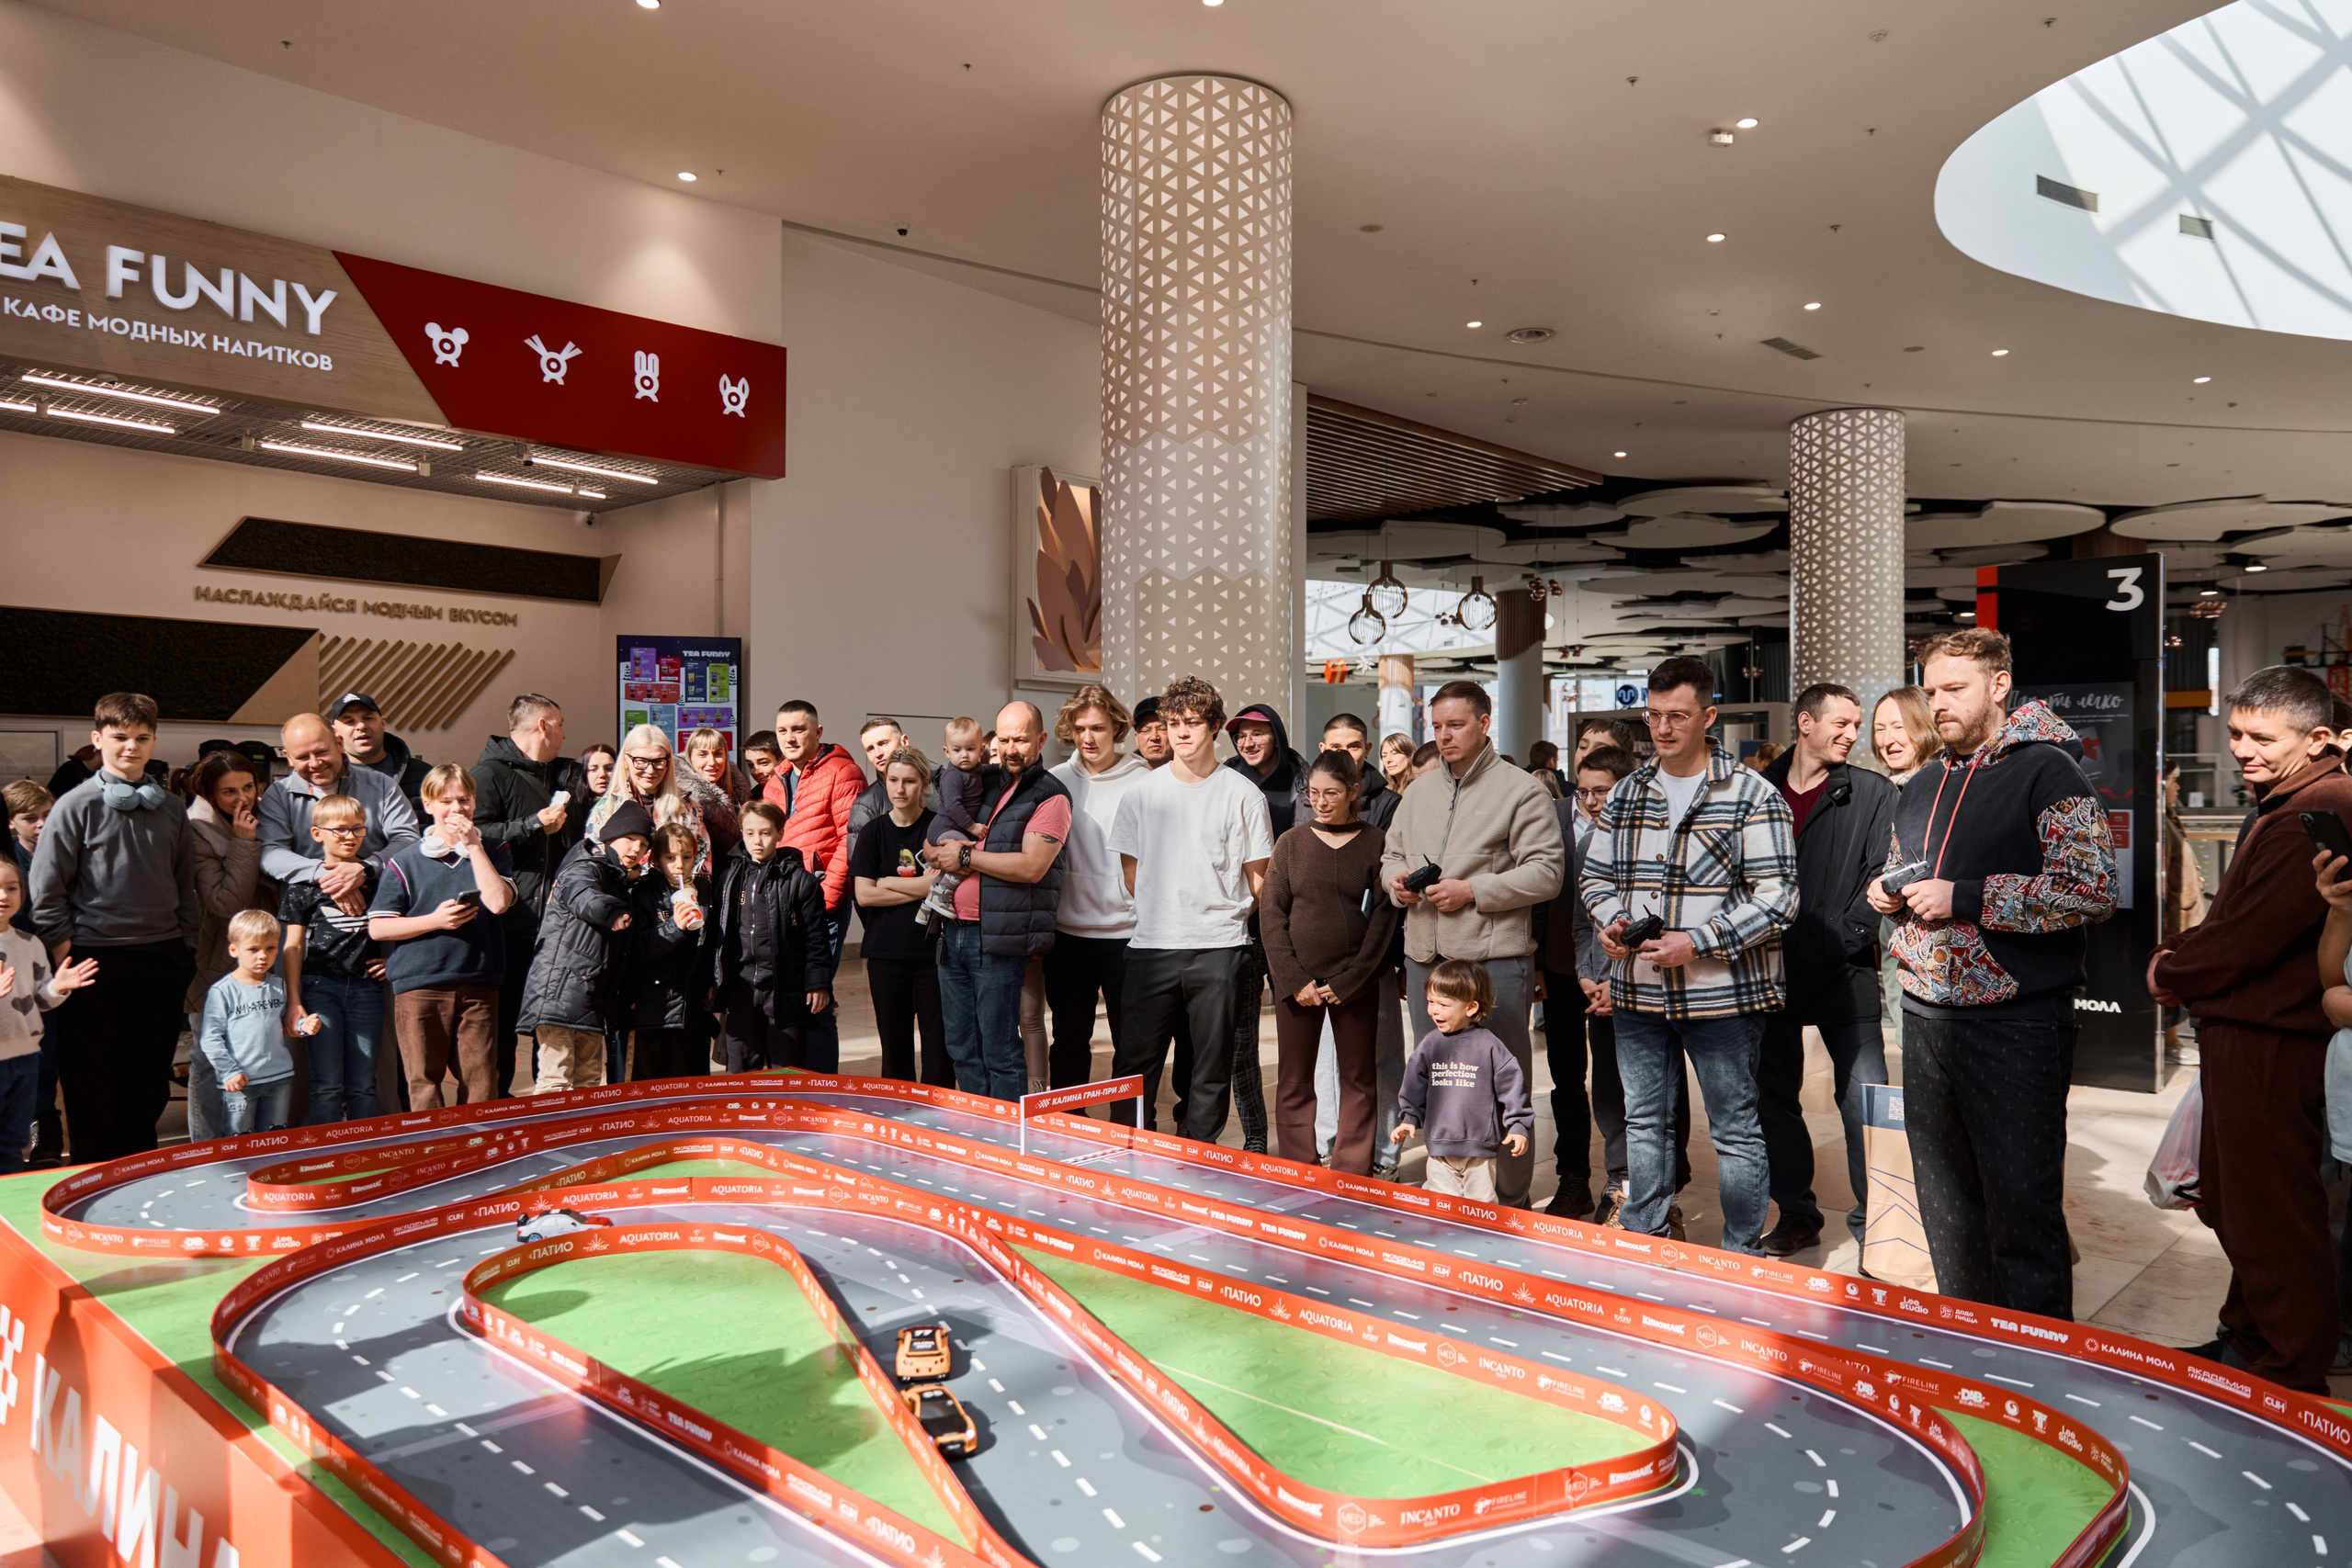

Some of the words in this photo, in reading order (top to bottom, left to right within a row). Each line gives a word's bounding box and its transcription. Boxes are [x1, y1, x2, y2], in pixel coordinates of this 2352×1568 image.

[106, 244, 338, 336] FUNNY
[3, 297, 81, 327] КАФЕ
[87, 313, 207, 351] МОДНЫХ
[212, 335, 333, 372] НАПИТКОВ
[2105, 567, 2144, 612] 3
[195, 585, 357, 614] НАСЛАЖДАЙСЯ
[363, 601, 443, 621] МОДНЫМ
[449, 607, 518, 627] ВКУСОМ
[2074, 998, 2122, 1013] МОЛЛ
[1431, 1070, 1476, 1079] perfection
[1450, 1062, 1458, 1070] is
[1459, 1062, 1479, 1072] how
[650, 1082, 690, 1093] AQUATORIA
[863, 1083, 894, 1091] AQUATORIA
[949, 1094, 967, 1103] INCANTO
[1052, 1094, 1082, 1105] КАЛИНА
[1083, 1087, 1117, 1100] ГРАН-ПРИ
[668, 1116, 712, 1124] AQUATORIA
[326, 1126, 373, 1138] AQUATORIA
[1082, 1124, 1101, 1134] FUNNY
[379, 1148, 415, 1159] INCANTO
[936, 1142, 947, 1151] TEA
[121, 1163, 146, 1173] КАЛИНА
[147, 1158, 165, 1167] МОЛЛ
[631, 1154, 651, 1163] КАЛИНА
[981, 1154, 999, 1163] КАЛИНА
[300, 1161, 334, 1173] КИНОМАКС
[417, 1163, 446, 1175] INCANTO
[1260, 1163, 1298, 1177] AQUATORIA
[351, 1180, 383, 1193] КИНОМАКС
[711, 1185, 763, 1195] AQUATORIA
[1346, 1183, 1368, 1193] КАЛИНА
[1370, 1188, 1386, 1196] МОЛЛ
[264, 1193, 316, 1203] AQUATORIA
[562, 1191, 619, 1205] AQUATORIA
[858, 1192, 889, 1204] INCANTO
[1121, 1187, 1159, 1203] AQUATORIA
[394, 1217, 438, 1233] АКАДЕМИЯ
[1210, 1210, 1226, 1221] TEA
[1227, 1215, 1253, 1228] FUNNY
[90, 1232, 124, 1243] INCANTO
[1261, 1222, 1277, 1234] TEA
[1278, 1227, 1307, 1241] FUNNY
[1533, 1221, 1583, 1240] AQUATORIA
[336, 1240, 364, 1254] КАЛИНА
[365, 1233, 385, 1244] МОЛЛ
[619, 1231, 680, 1246] AQUATORIA
[1033, 1232, 1048, 1244] TEA
[1049, 1237, 1075, 1252] FUNNY
[1615, 1238, 1651, 1252] КИНОМАКС
[1329, 1241, 1355, 1253] КАЛИНА
[1356, 1247, 1375, 1258] МОЛЛ
[1102, 1253, 1126, 1265] КАЛИНА
[1127, 1259, 1145, 1270] МОЛЛ
[1699, 1254, 1741, 1270] INCANTO
[1764, 1269, 1794, 1280] FIRELINE
[1545, 1293, 1604, 1315] AQUATORIA
[1903, 1296, 1919, 1306] Lee
[1900, 1303, 1928, 1315] Studio
[1955, 1309, 1974, 1317] ДОДО
[1300, 1309, 1354, 1333] AQUATORIA
[1642, 1314, 1685, 1335] КИНОМАКС
[1955, 1315, 1978, 1324] ПИЦЦА
[1699, 1331, 1715, 1342] MED
[1990, 1318, 2018, 1332] TEA
[2020, 1323, 2069, 1344] FUNNY
[1439, 1349, 1454, 1359] MED
[1741, 1340, 1788, 1362] INCANTO
[2101, 1343, 2143, 1362] КАЛИНА
[2146, 1355, 2175, 1371] МОЛЛ
[1479, 1357, 1525, 1379] INCANTO
[1813, 1365, 1842, 1381] FIRELINE
[1902, 1376, 1939, 1391] FIRELINE
[2188, 1366, 2251, 1393] АКАДЕМИЯ
[1552, 1380, 1585, 1395] FIRELINE
[668, 1411, 684, 1427] TEA
[685, 1420, 713, 1442] FUNNY
[2062, 1425, 2076, 1440] Lee
[2058, 1431, 2083, 1452] Studio
[30, 1353, 239, 1568] КАЛИН
[734, 1448, 760, 1468] КАЛИНА
[761, 1461, 781, 1480] МОЛЛ
[1609, 1462, 1654, 1485] КИНОМАКС
[1568, 1479, 1585, 1492] MED
[1492, 1491, 1528, 1505] FIRELINE
[1341, 1512, 1363, 1525] MED
[1401, 1504, 1461, 1525] INCANTO
